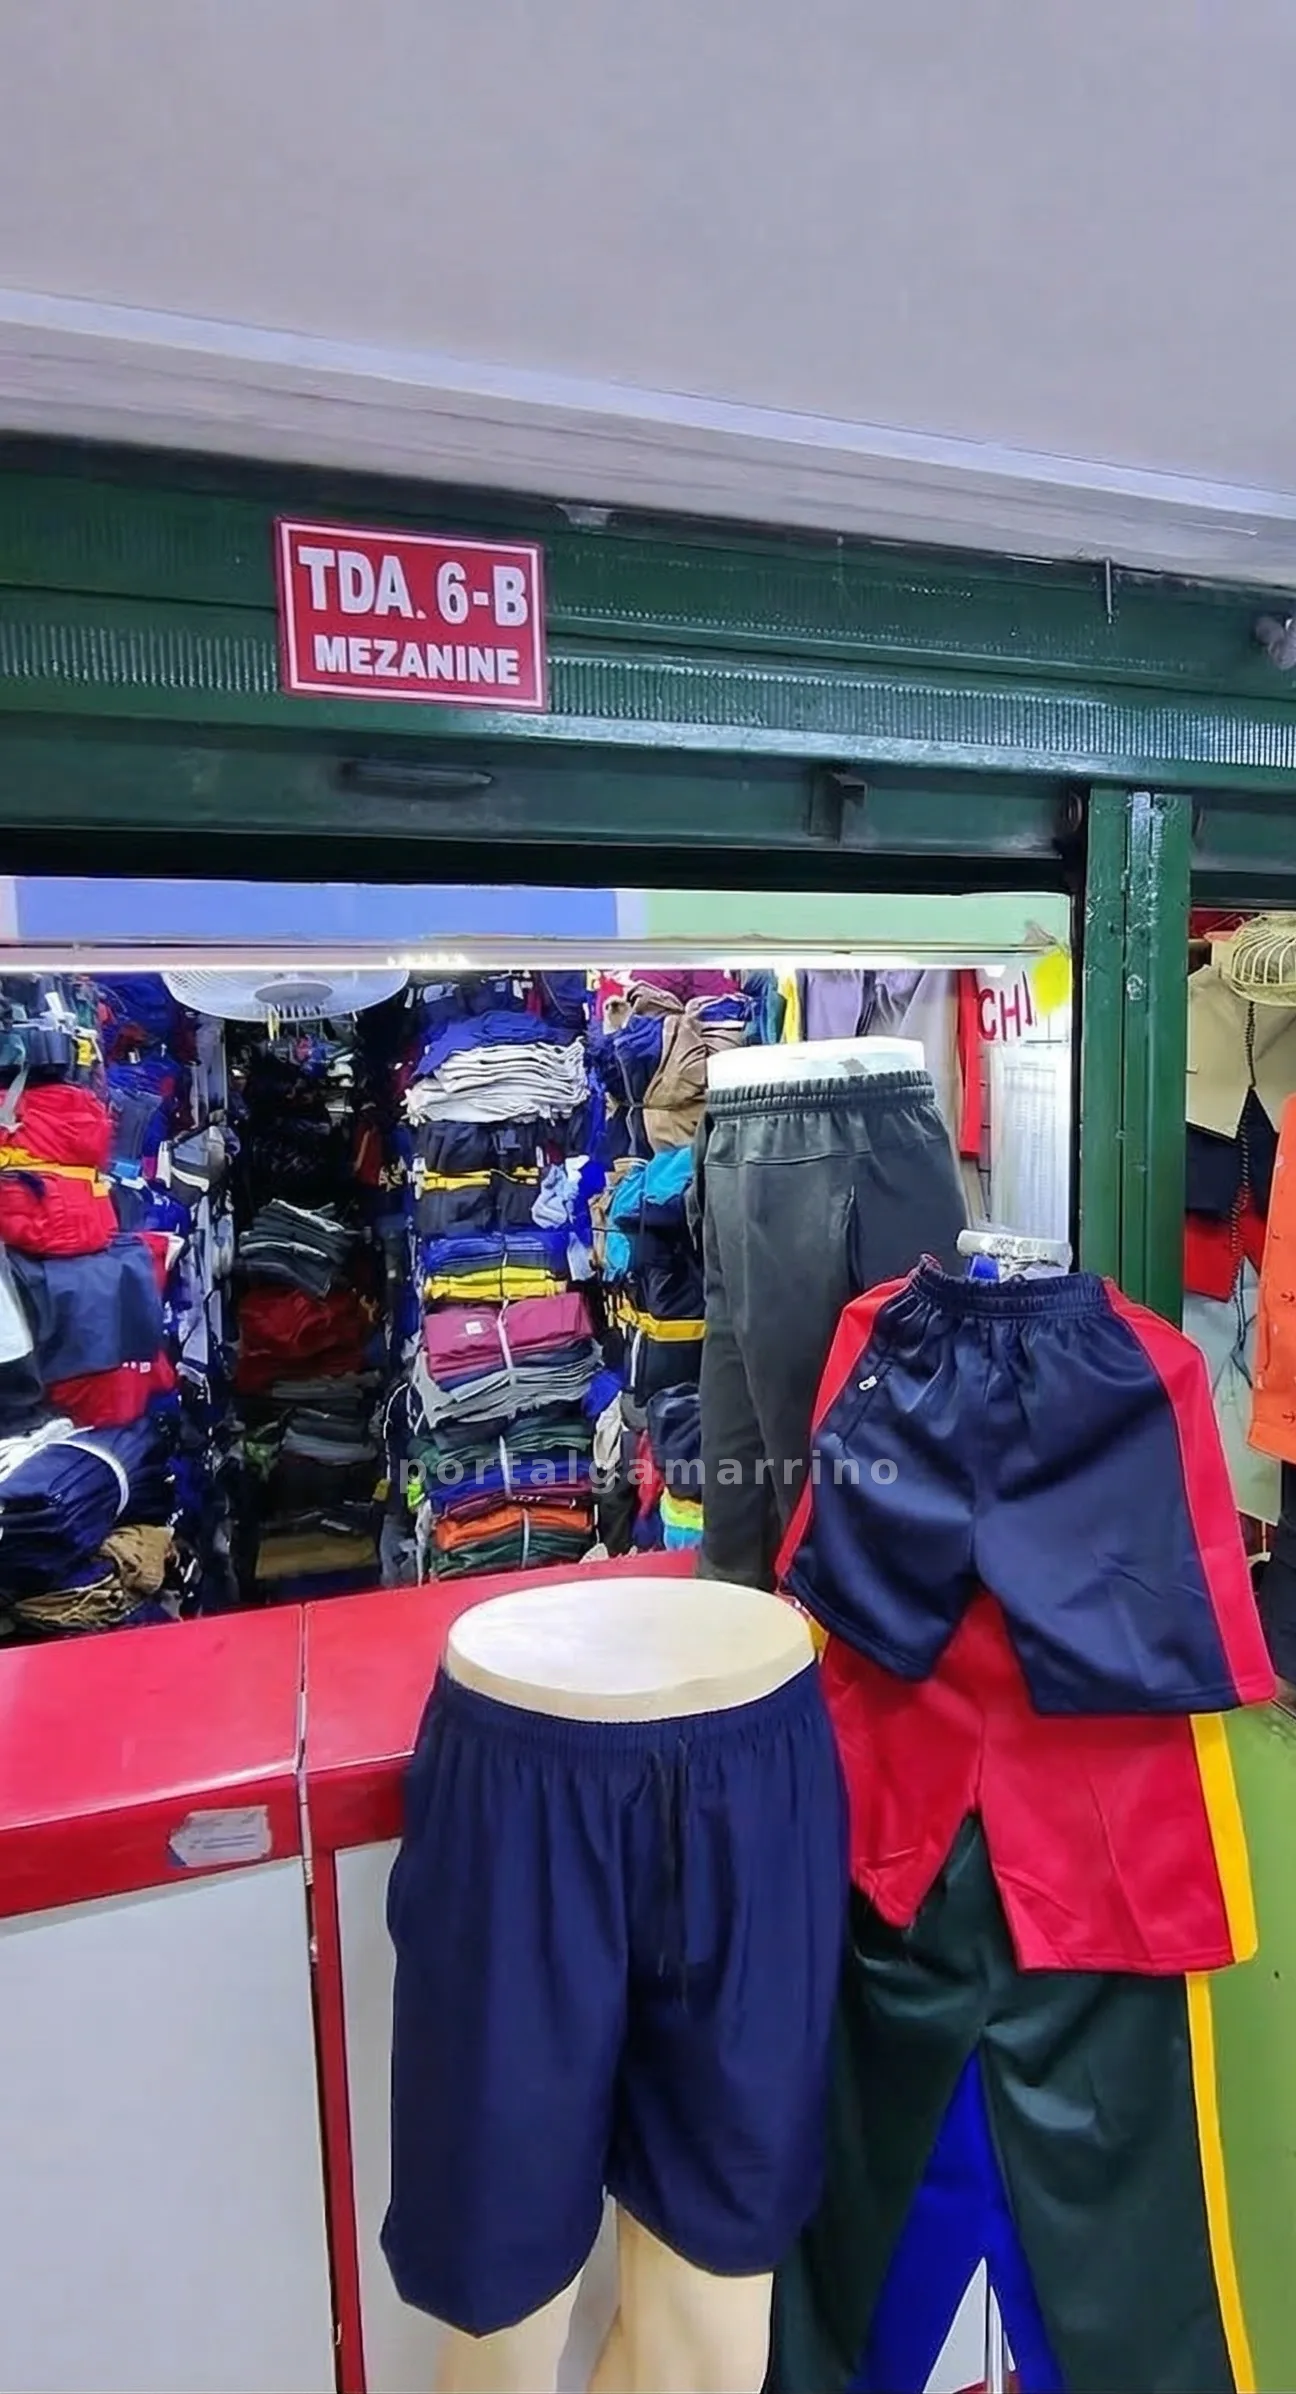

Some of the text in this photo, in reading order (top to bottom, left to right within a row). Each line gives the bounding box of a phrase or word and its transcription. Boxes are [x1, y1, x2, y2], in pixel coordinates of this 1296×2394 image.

[298, 546, 529, 627] TDA. 6-B
[313, 634, 521, 685] MEZANINE
